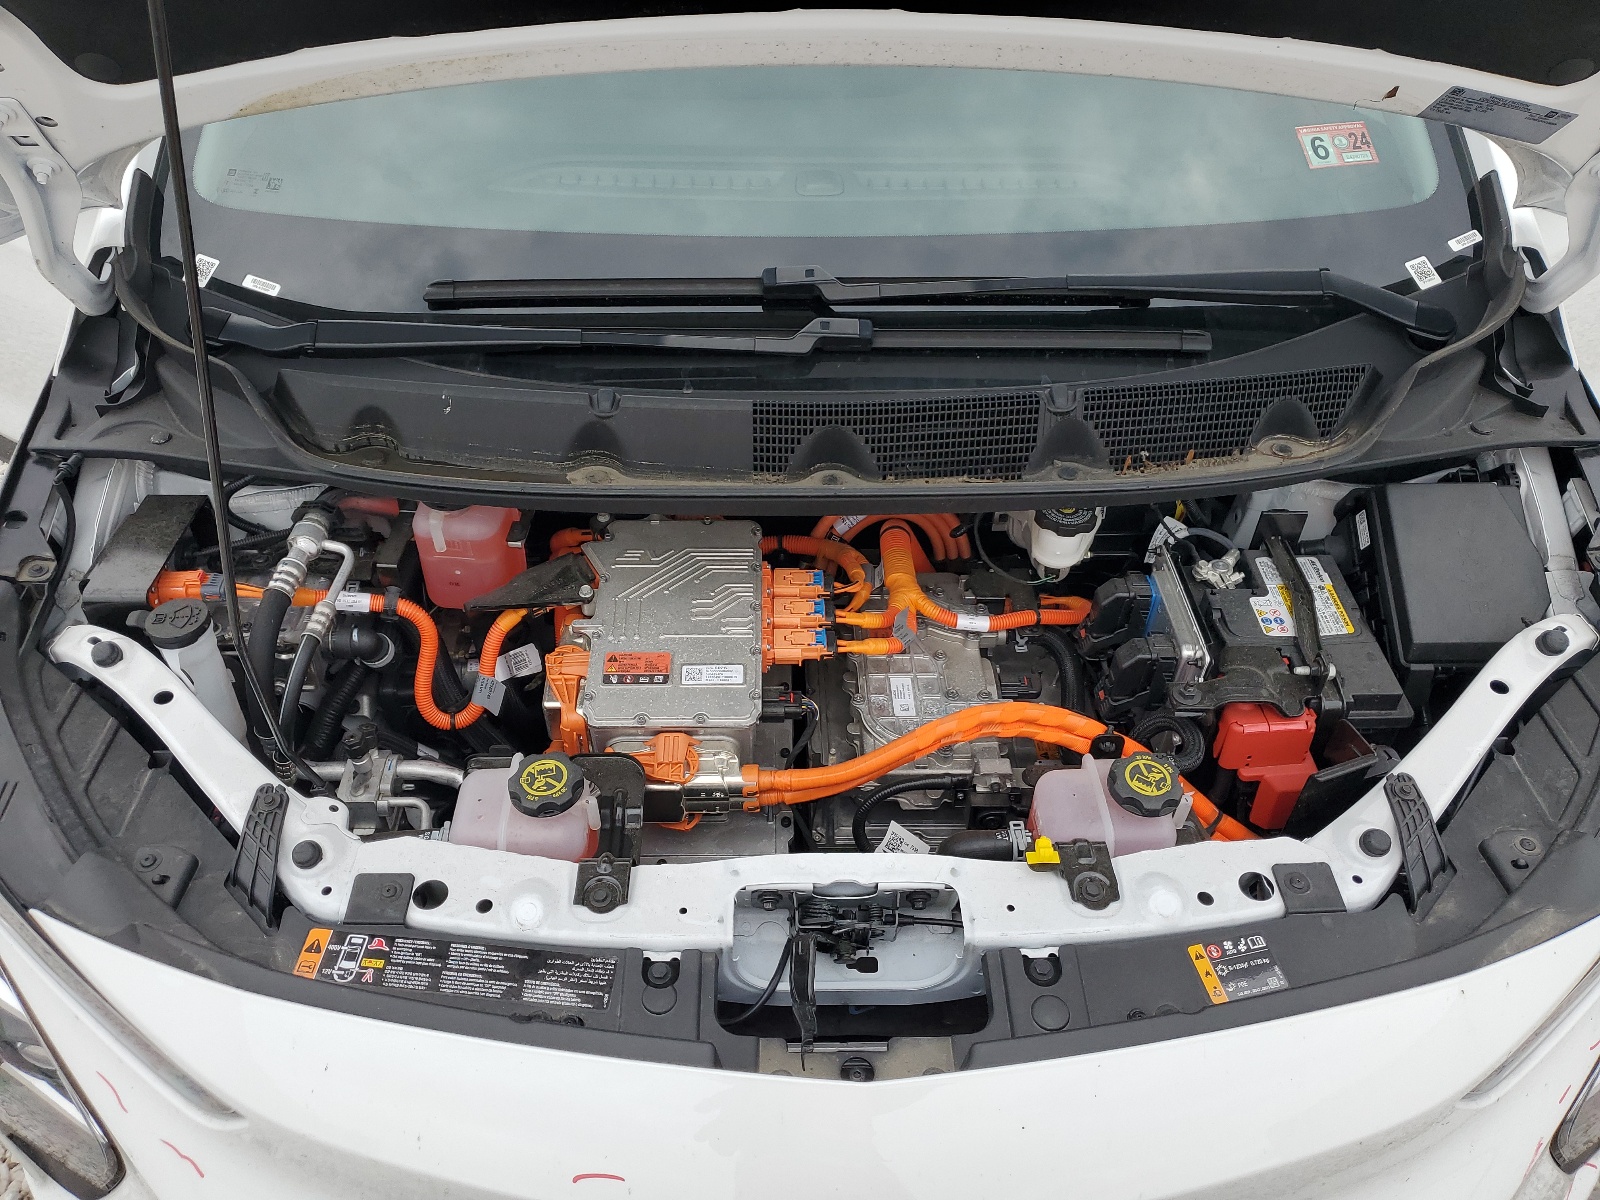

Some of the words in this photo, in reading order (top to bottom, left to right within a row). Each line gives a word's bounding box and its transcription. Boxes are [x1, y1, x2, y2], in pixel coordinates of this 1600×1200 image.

[1338, 123, 1364, 131] APPROVAL
[1310, 136, 1330, 161] 6
[1348, 131, 1372, 151] 24
